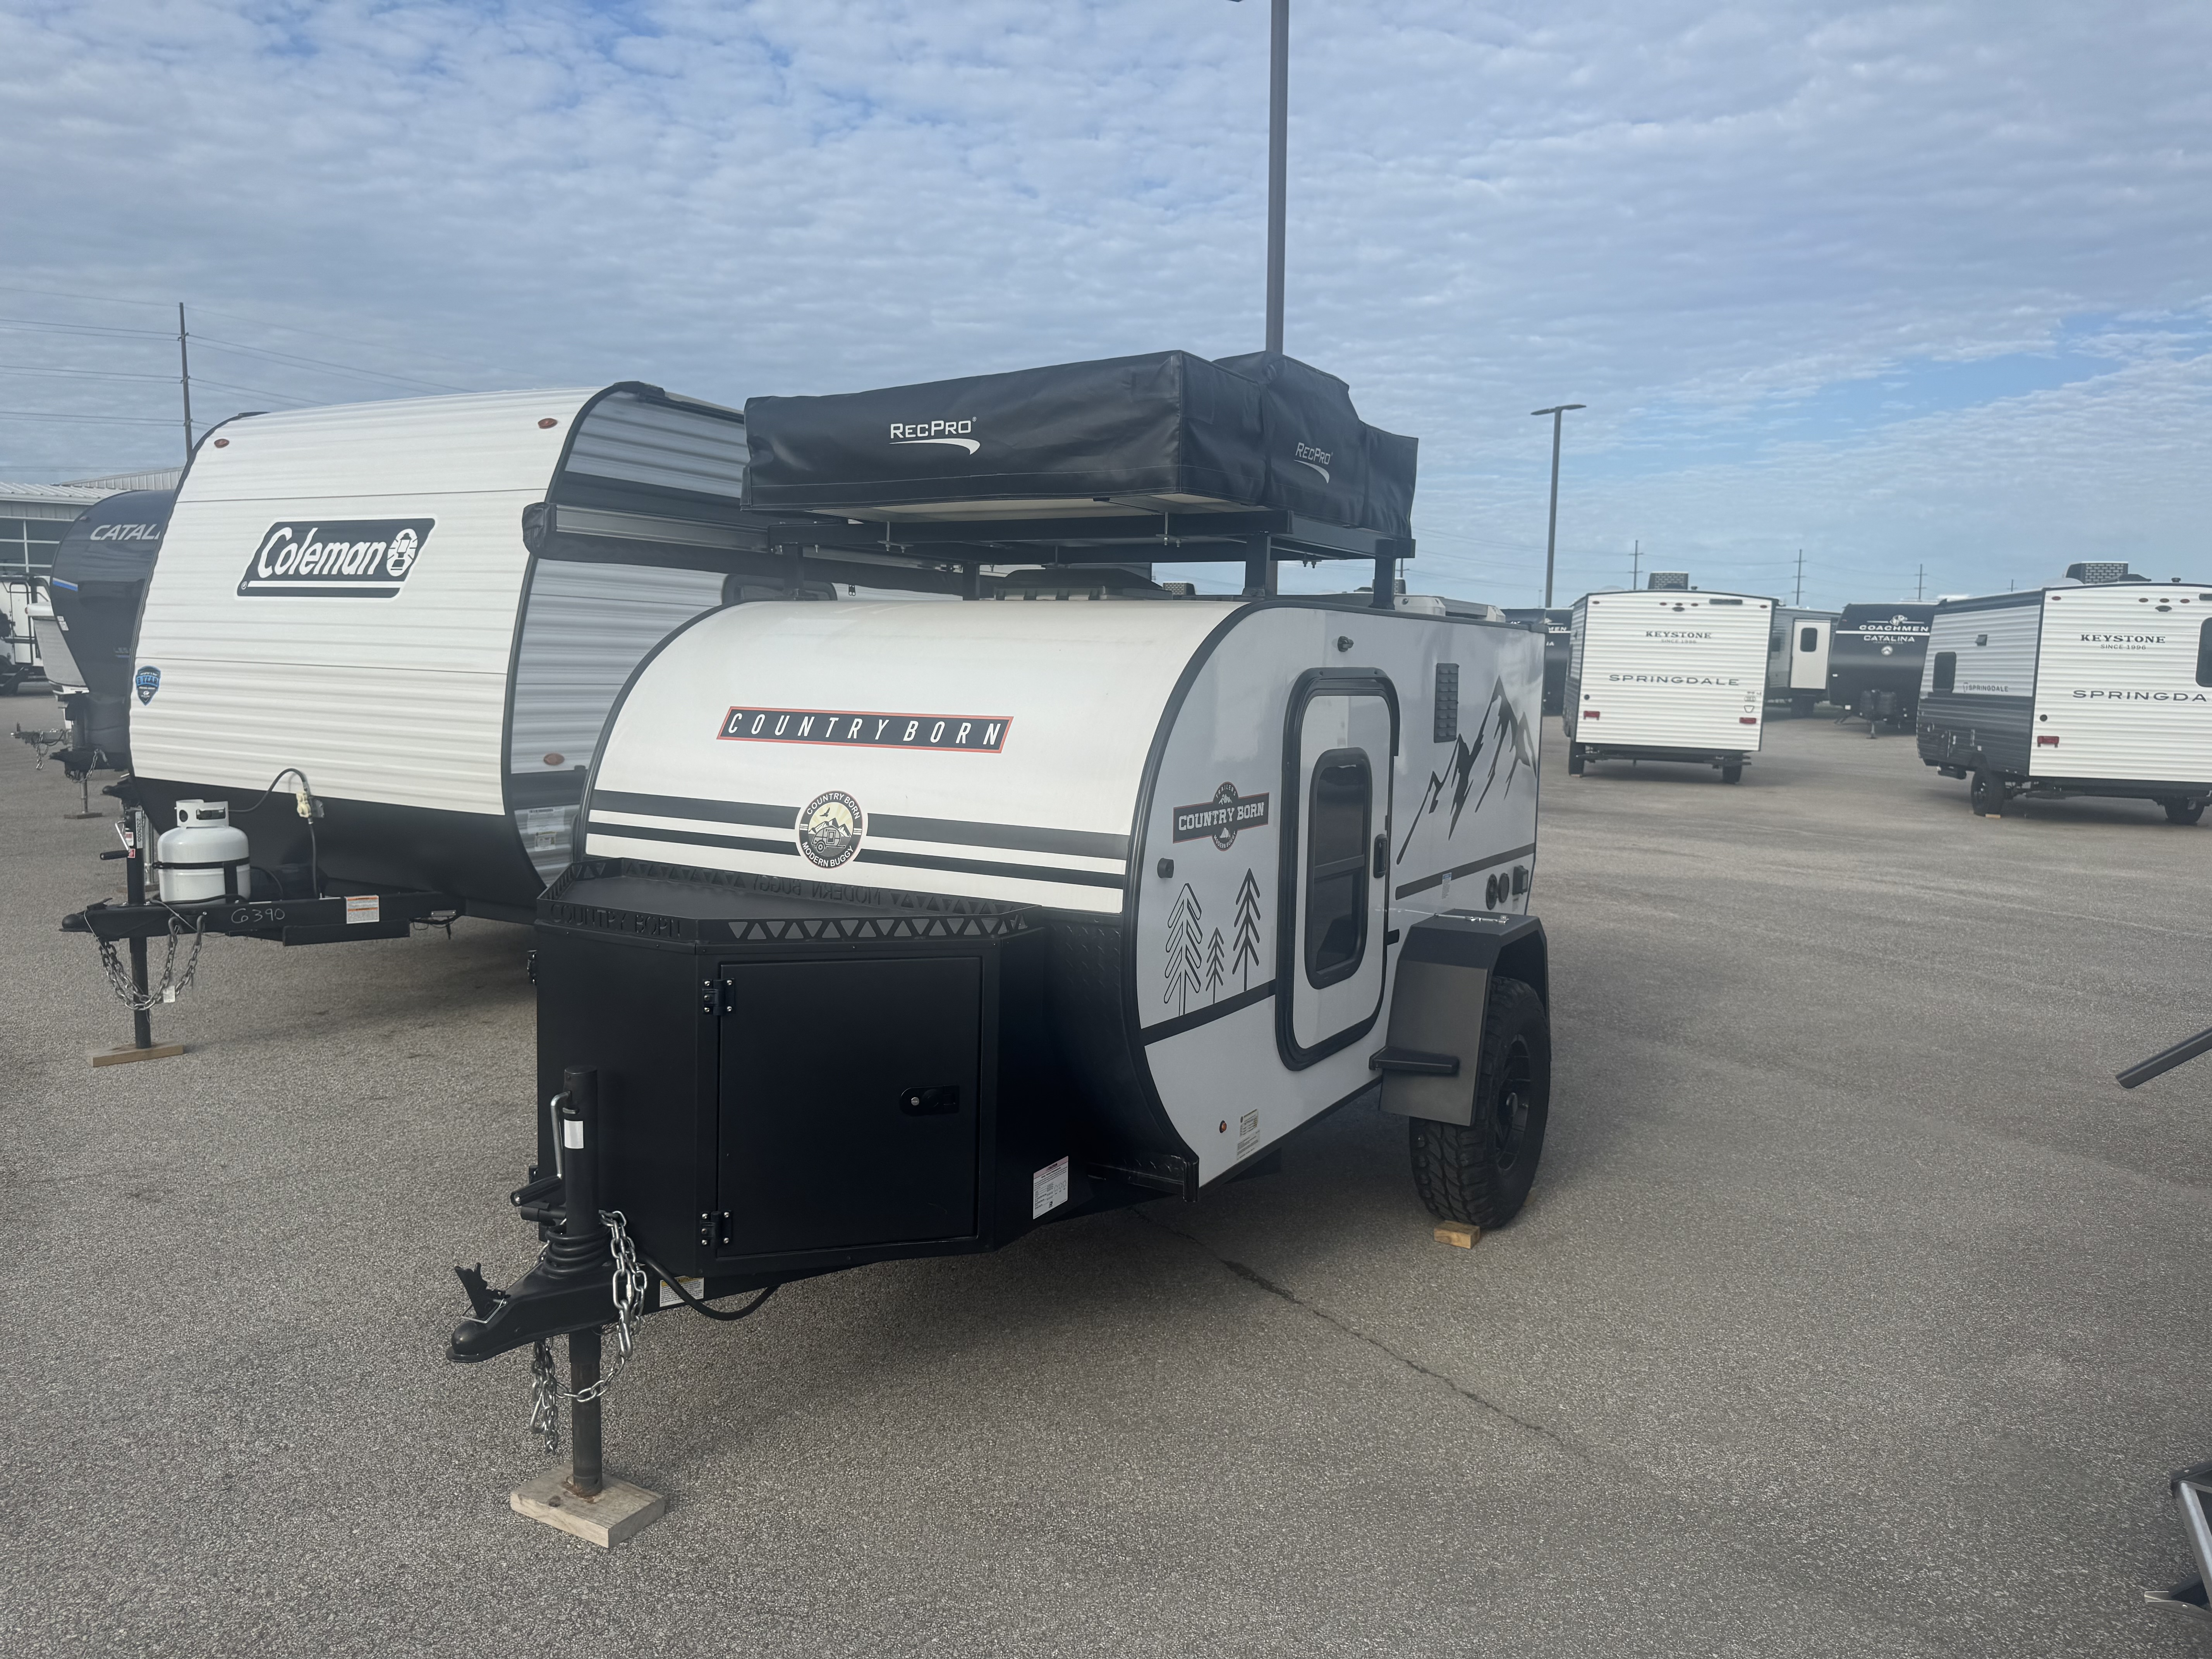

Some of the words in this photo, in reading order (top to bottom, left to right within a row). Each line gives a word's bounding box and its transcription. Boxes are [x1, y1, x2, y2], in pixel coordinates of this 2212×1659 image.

[258, 527, 386, 578] Coleman
[2080, 634, 2166, 643] KEYSTONE
[1609, 675, 1739, 685] SPRINGDALE
[2073, 690, 2212, 702] SPRINGDA
[1216, 784, 1236, 799] TRAILERS
[807, 793, 845, 815] COUNTRY
[844, 796, 860, 819] BORN
[1179, 807, 1235, 831] COUNTRY
[1237, 802, 1264, 821] BORN
[1214, 834, 1226, 849] MODERN
[802, 842, 829, 867] MODERN
[830, 845, 854, 867] BUGGY
